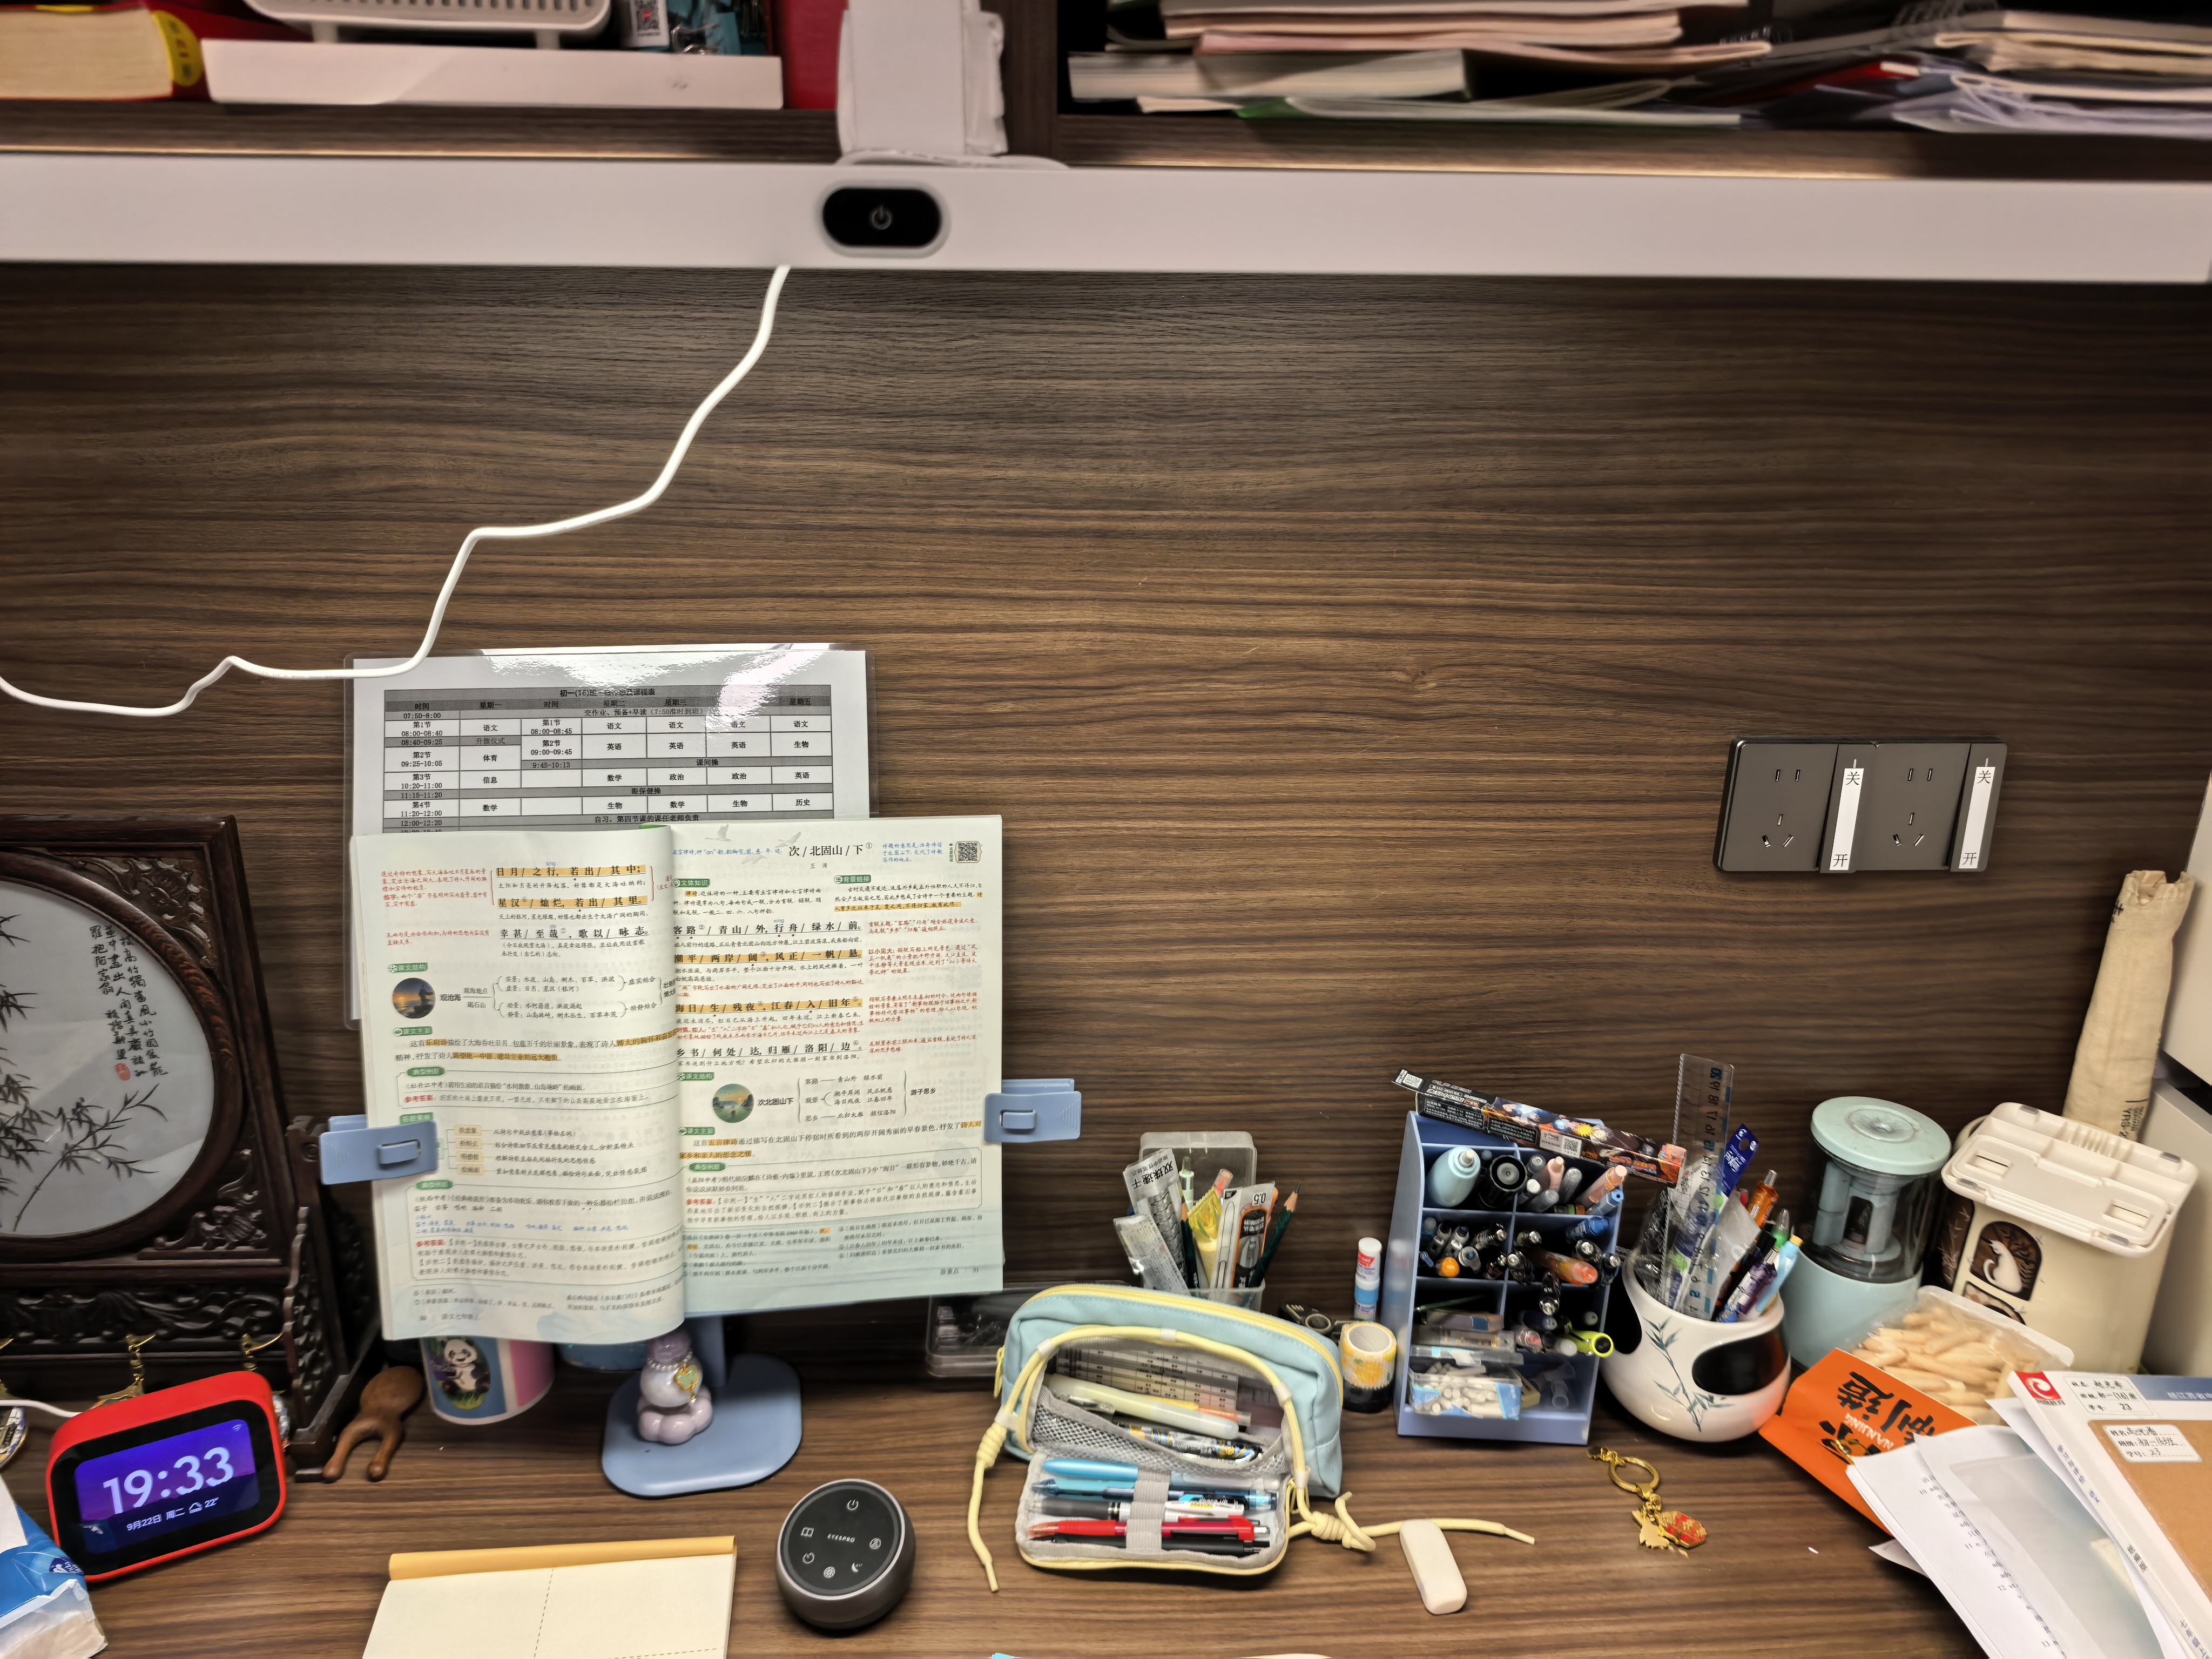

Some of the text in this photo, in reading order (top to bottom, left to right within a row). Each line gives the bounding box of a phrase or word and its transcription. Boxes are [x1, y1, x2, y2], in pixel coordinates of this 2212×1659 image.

[1846, 772, 1860, 785] 关
[1977, 770, 1991, 784] 关
[1833, 854, 1847, 867] 开
[1963, 853, 1977, 866] 开
[397, 963, 427, 972] 课文结构
[628, 977, 656, 986] 虚实结合
[440, 994, 461, 1002] 观沧海
[629, 1003, 657, 1011] 动静结合
[834, 1089, 861, 1097] 潮平岸阔
[867, 1087, 893, 1095] 风正帆悬
[911, 1088, 936, 1096] 游子思乡
[757, 1098, 794, 1106] 次北固山下
[834, 1097, 861, 1105] 海日残夜
[867, 1095, 894, 1103] 江春旧年
[838, 1111, 864, 1119] 北归大雁
[870, 1109, 896, 1117] 捎信洛阳
[1131, 1161, 1174, 1189] 双珠速干
[1253, 1192, 1266, 1205] 0.5
[1844, 1413, 1894, 1450] NANJING
[2150, 1448, 2161, 1456] 23
[103, 1446, 234, 1515] 19:33
[127, 1514, 162, 1532] 9月22日
[166, 1508, 186, 1521] 周二
